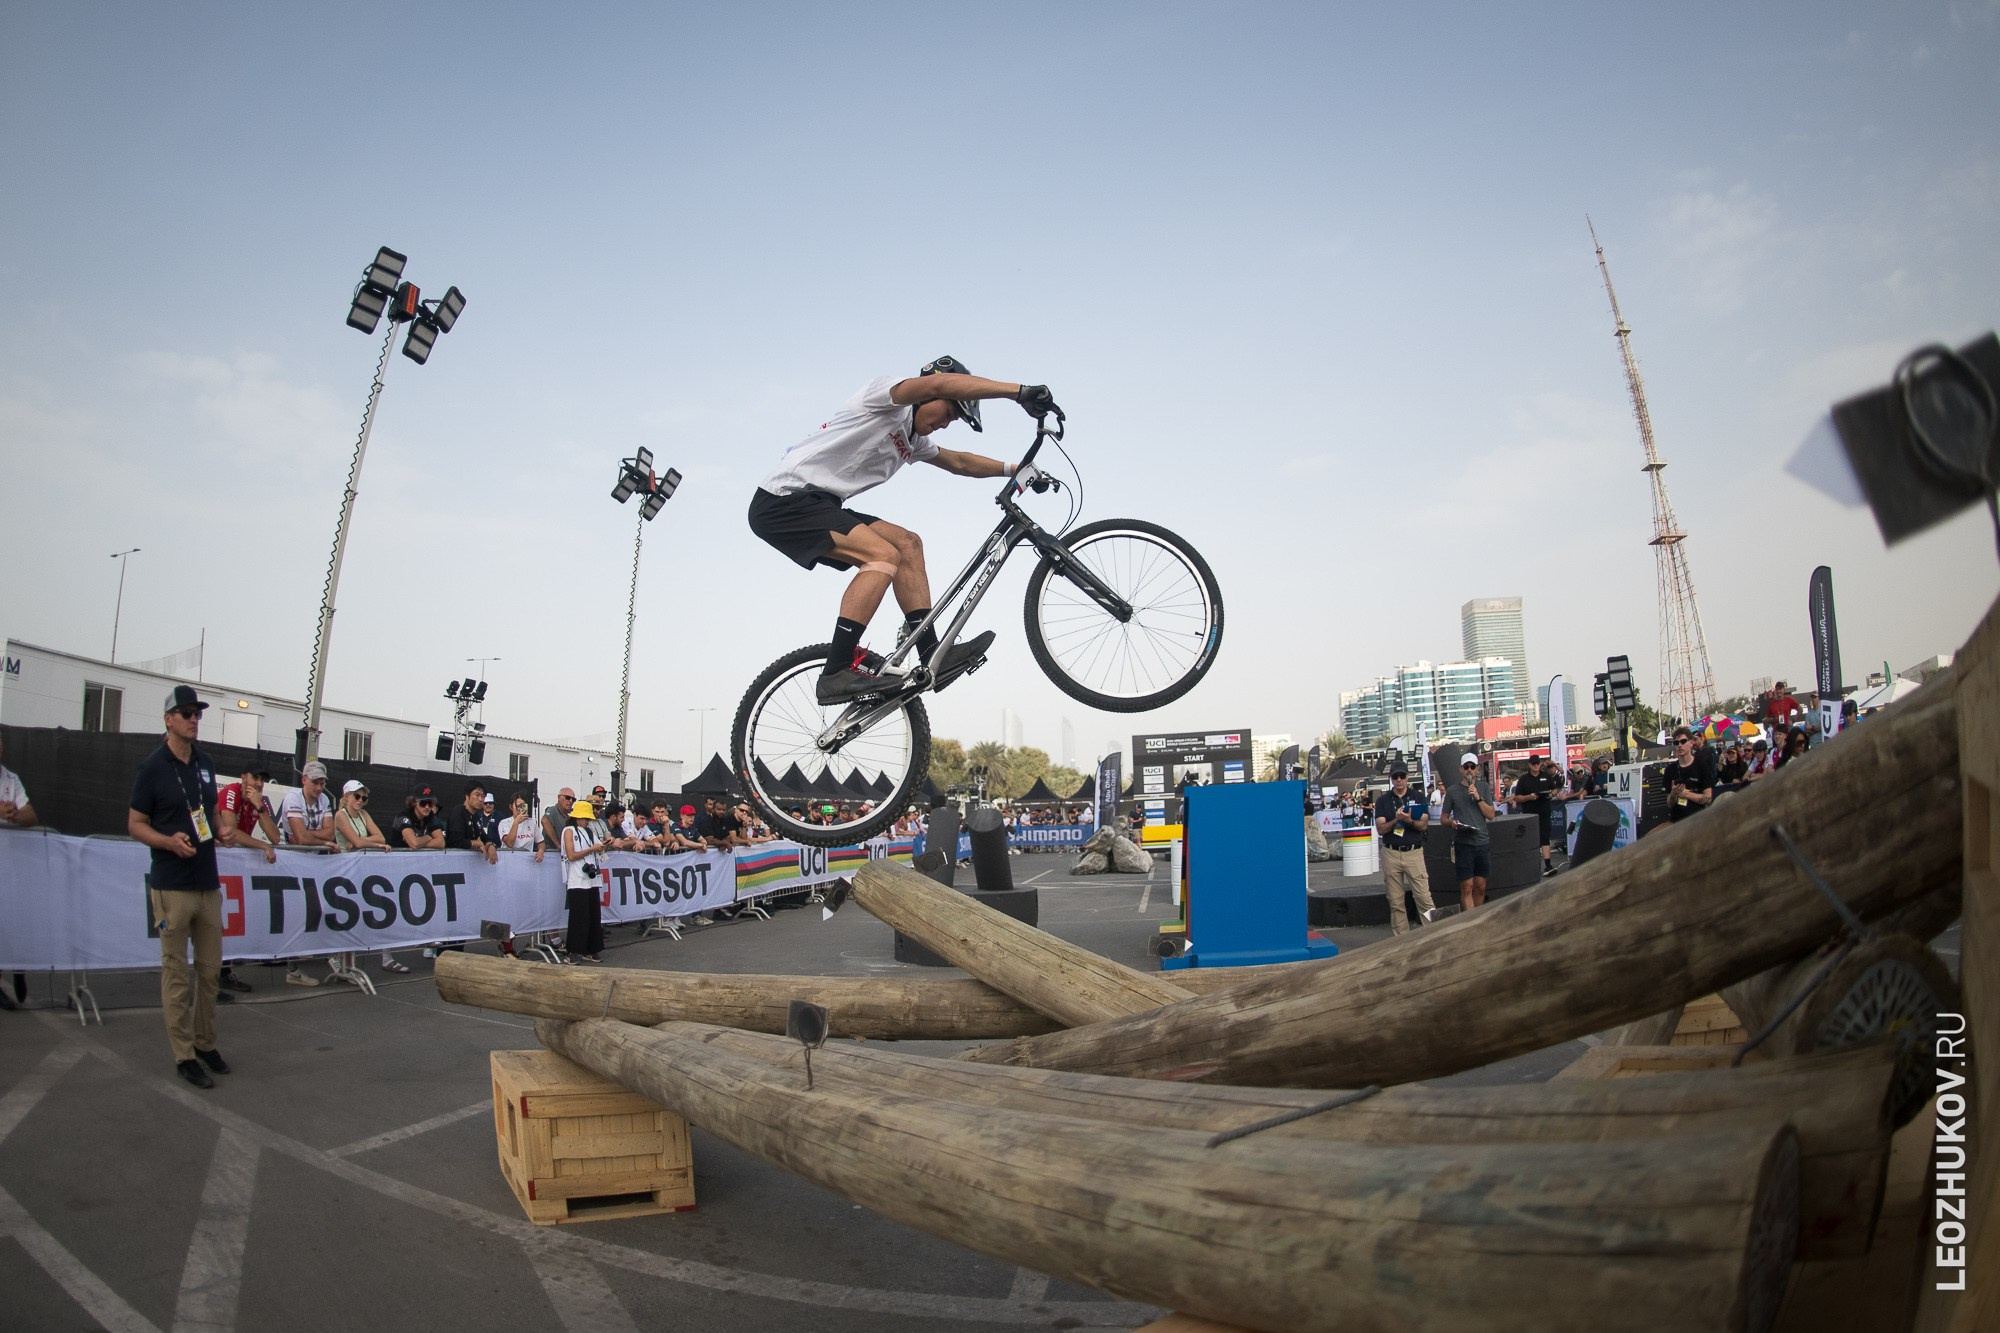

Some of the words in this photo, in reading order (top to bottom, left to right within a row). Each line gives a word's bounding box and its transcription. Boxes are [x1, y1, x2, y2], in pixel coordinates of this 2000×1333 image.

[1184, 754, 1205, 762] START
[800, 847, 826, 877] UCI
[612, 863, 711, 905] TISSOT
[251, 872, 466, 935] TISSOT
